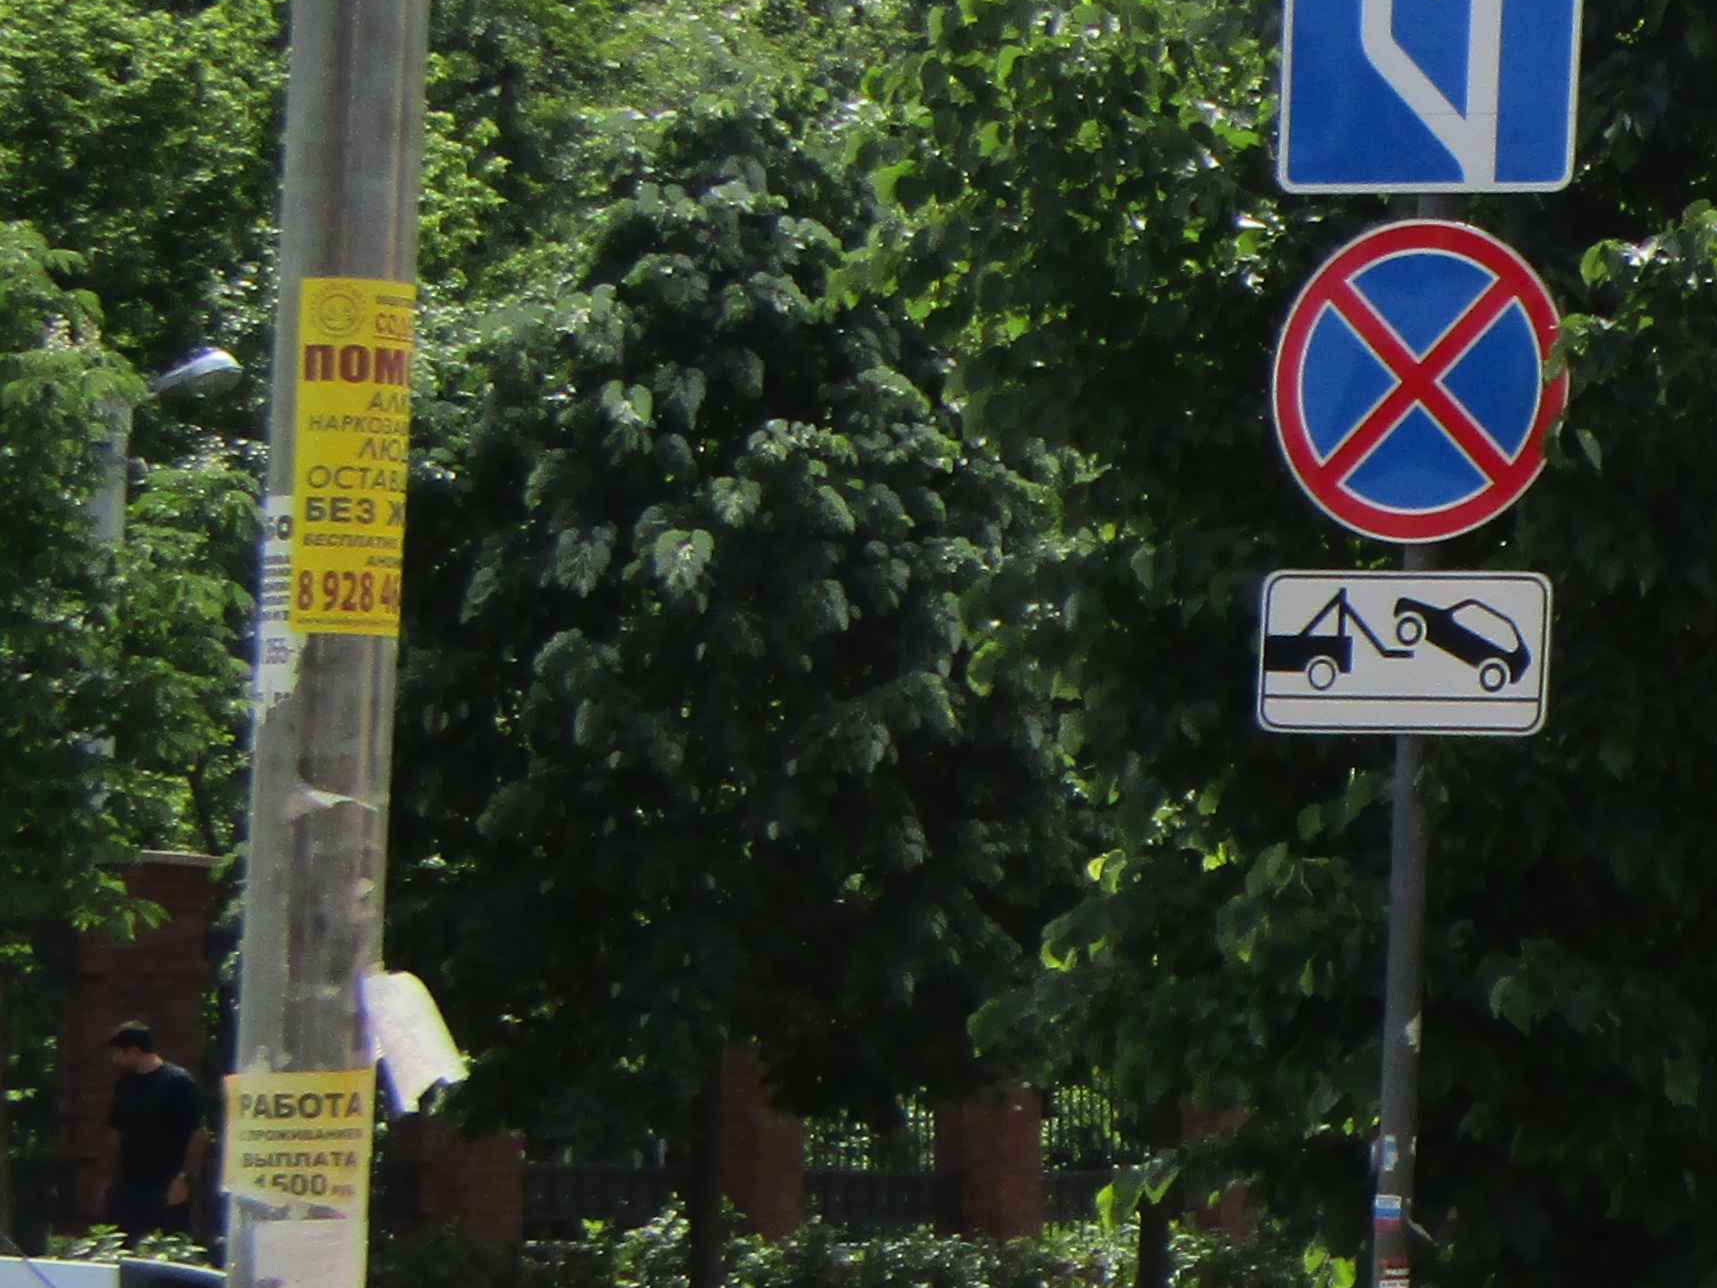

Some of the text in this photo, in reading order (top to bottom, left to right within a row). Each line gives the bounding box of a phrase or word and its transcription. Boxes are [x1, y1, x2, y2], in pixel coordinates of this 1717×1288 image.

[306, 497, 375, 524] БЕЗ
[297, 570, 314, 611] 8
[322, 570, 375, 612] 928
[240, 1092, 363, 1119] РАБОТА
[243, 1151, 357, 1167] ВЫПЛАТА
